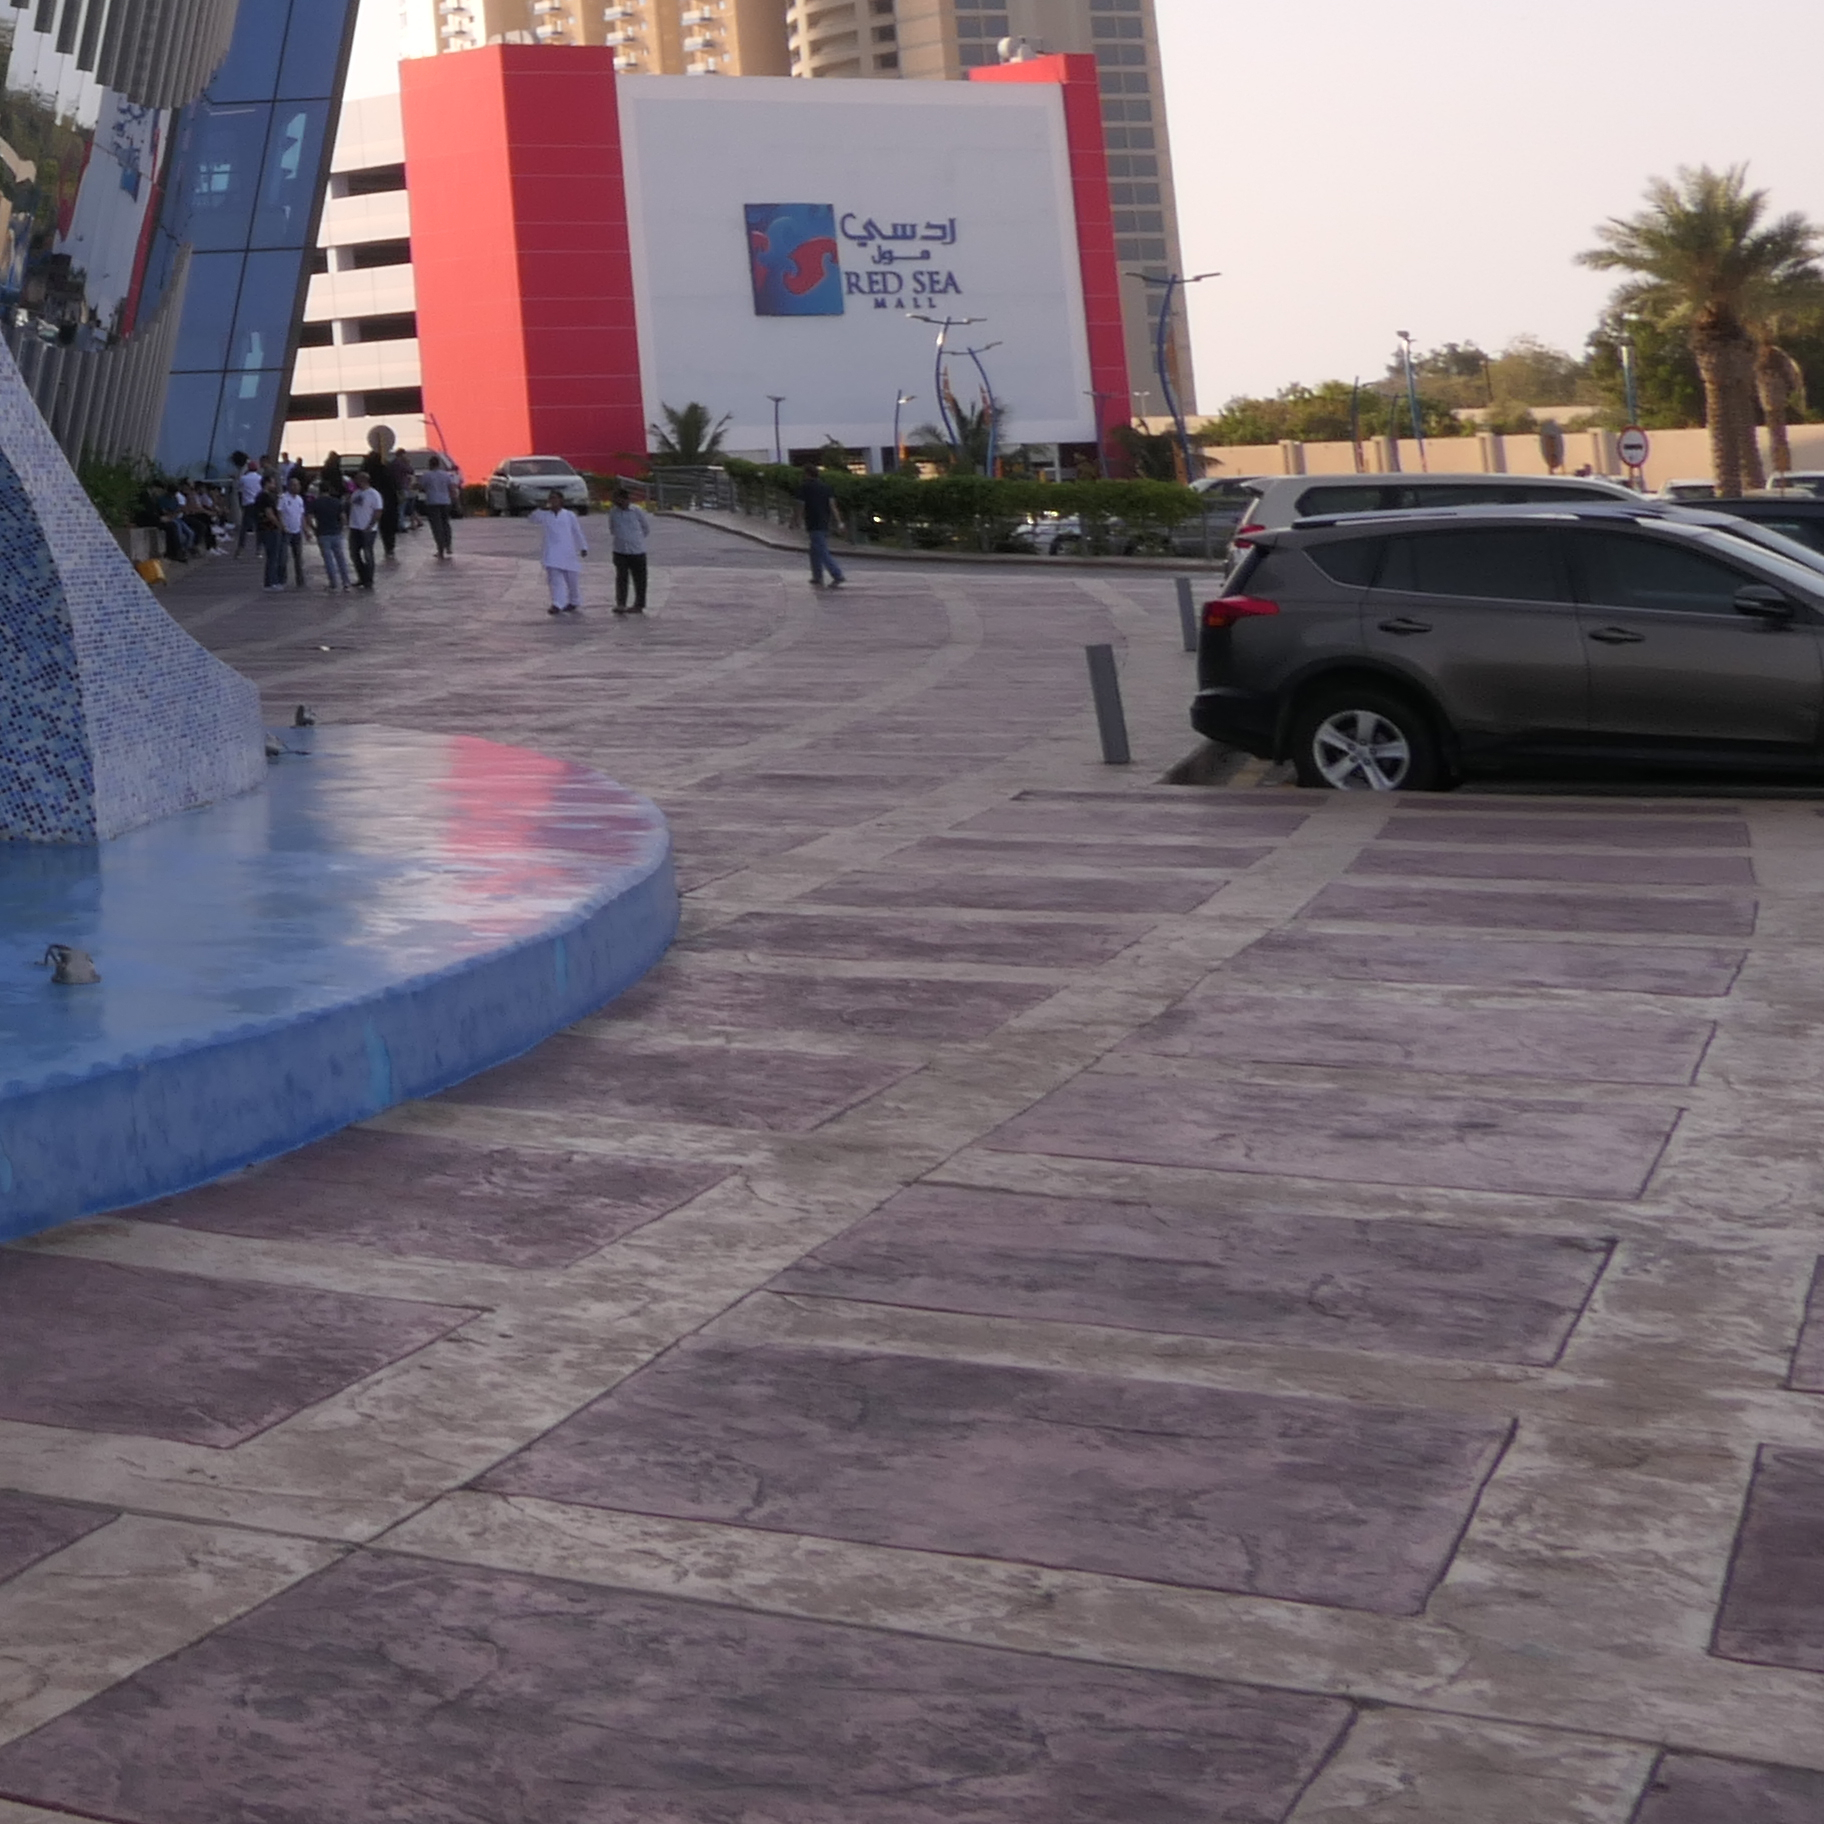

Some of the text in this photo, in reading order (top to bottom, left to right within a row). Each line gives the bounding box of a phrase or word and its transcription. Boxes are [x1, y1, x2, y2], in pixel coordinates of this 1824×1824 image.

[843, 271, 963, 295] RED SEA
[873, 297, 937, 310] MALL
